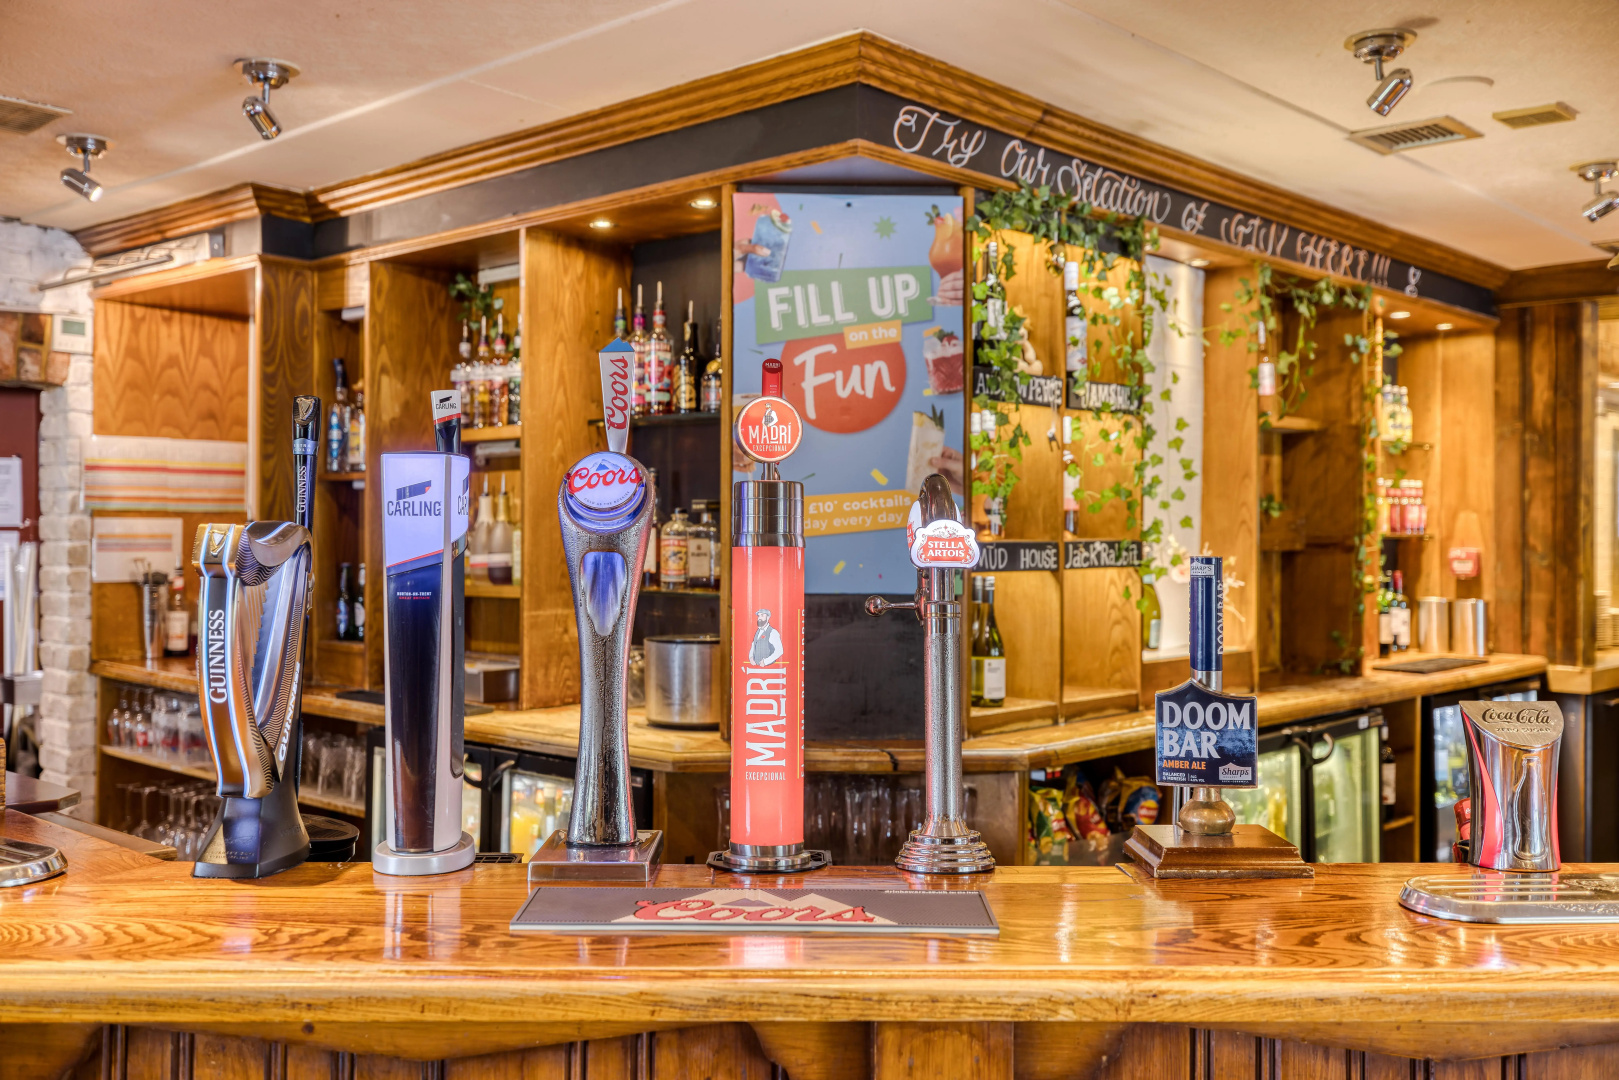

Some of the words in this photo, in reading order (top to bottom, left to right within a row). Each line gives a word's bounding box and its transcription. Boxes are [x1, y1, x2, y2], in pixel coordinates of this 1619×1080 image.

[893, 105, 987, 168] Try
[1001, 139, 1056, 186] Our
[1057, 158, 1172, 224] Selection
[767, 281, 856, 331] FILL
[868, 274, 920, 318] UP
[849, 330, 868, 342] on
[871, 326, 897, 340] the
[607, 355, 630, 431] Coors
[793, 344, 896, 420] Fun
[435, 402, 457, 410] CARLING
[748, 422, 792, 444] MADRÍ
[752, 444, 788, 452] EXCEPCIONAL
[296, 465, 307, 513] GUINNESS
[567, 466, 643, 495] Coors
[387, 500, 442, 516] CARLING
[843, 494, 912, 511] cocktails
[804, 517, 828, 531] day
[833, 514, 873, 527] every
[877, 511, 904, 525] day
[927, 540, 965, 549] STELLA
[927, 549, 965, 557] ARTOIS
[974, 546, 1009, 571] MUD
[1020, 547, 1058, 569] HOUSE
[207, 608, 228, 705] GUINNESS
[741, 666, 787, 767] MADRÍ
[1162, 700, 1251, 730] DOOM
[1481, 708, 1552, 724] Coca-Cola
[1162, 730, 1221, 759] BAR
[1162, 759, 1190, 770] AMBER
[1191, 761, 1207, 770] ALE
[1221, 767, 1249, 778] Sharp's
[745, 771, 786, 781] EXCEPCIONAL
[634, 898, 877, 923] Coors
